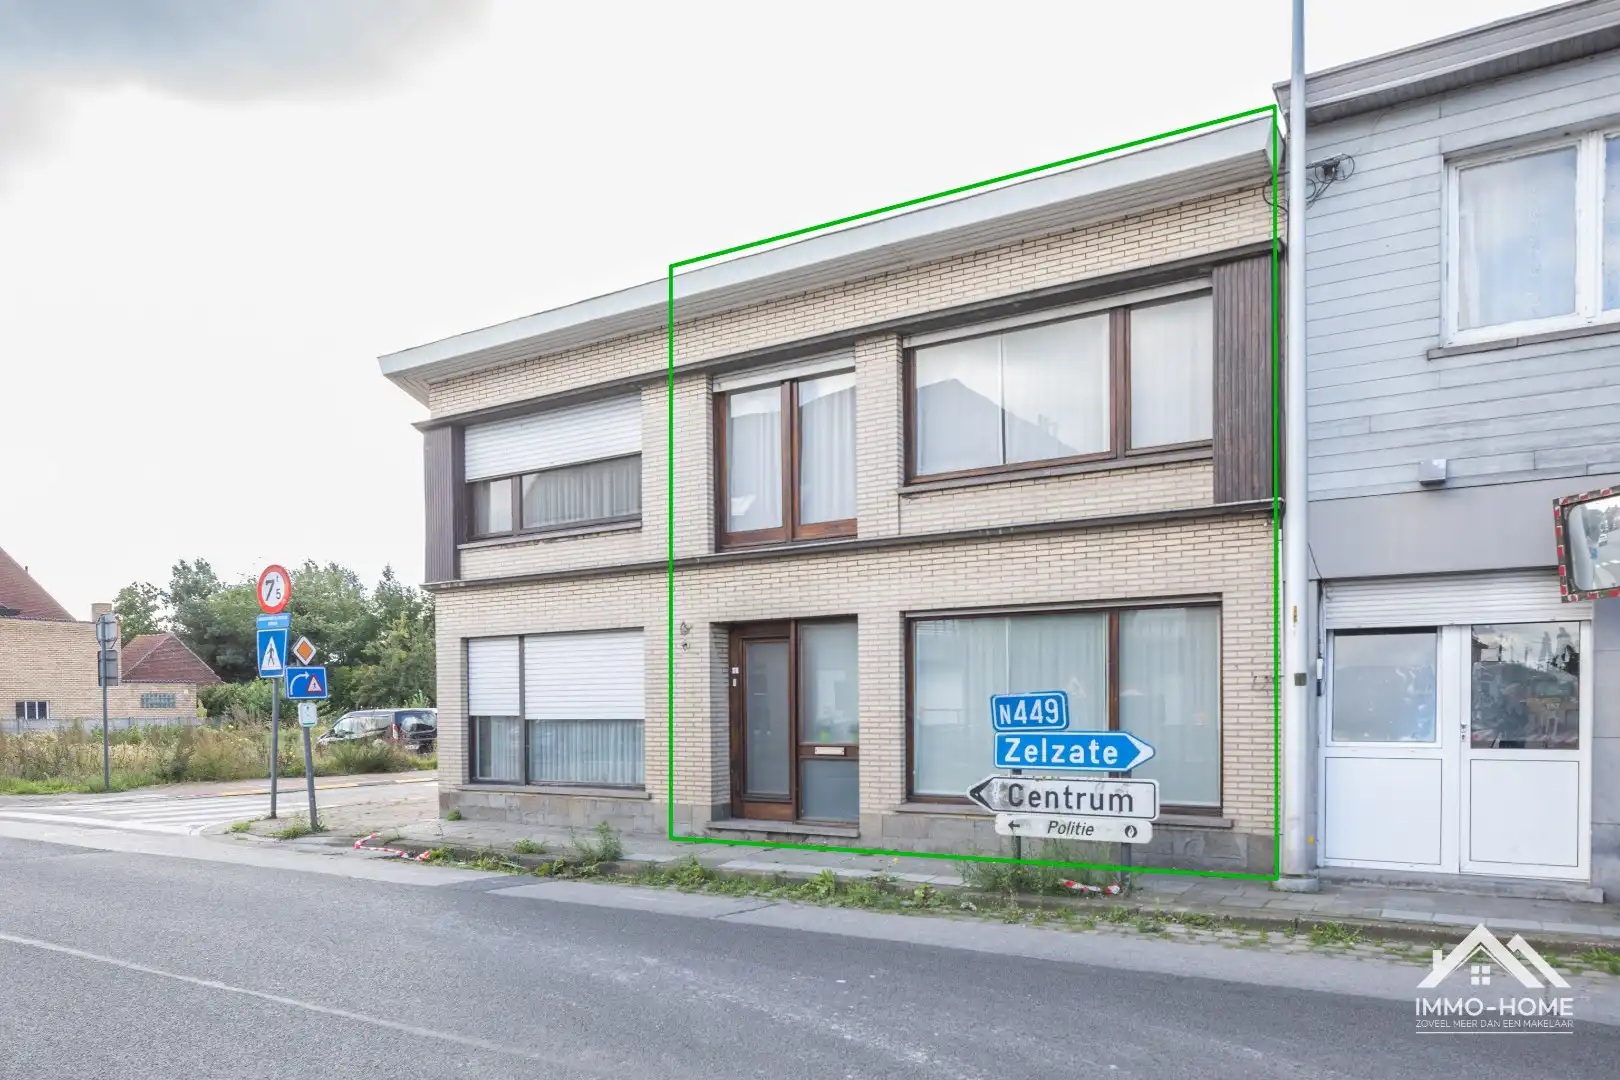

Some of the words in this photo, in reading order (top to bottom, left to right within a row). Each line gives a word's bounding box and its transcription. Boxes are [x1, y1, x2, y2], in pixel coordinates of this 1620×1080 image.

[265, 579, 275, 601] 7
[999, 698, 1060, 725] N449
[1004, 737, 1119, 765] Zelzate
[1008, 783, 1134, 813] Centrum
[1047, 820, 1095, 837] Politie
